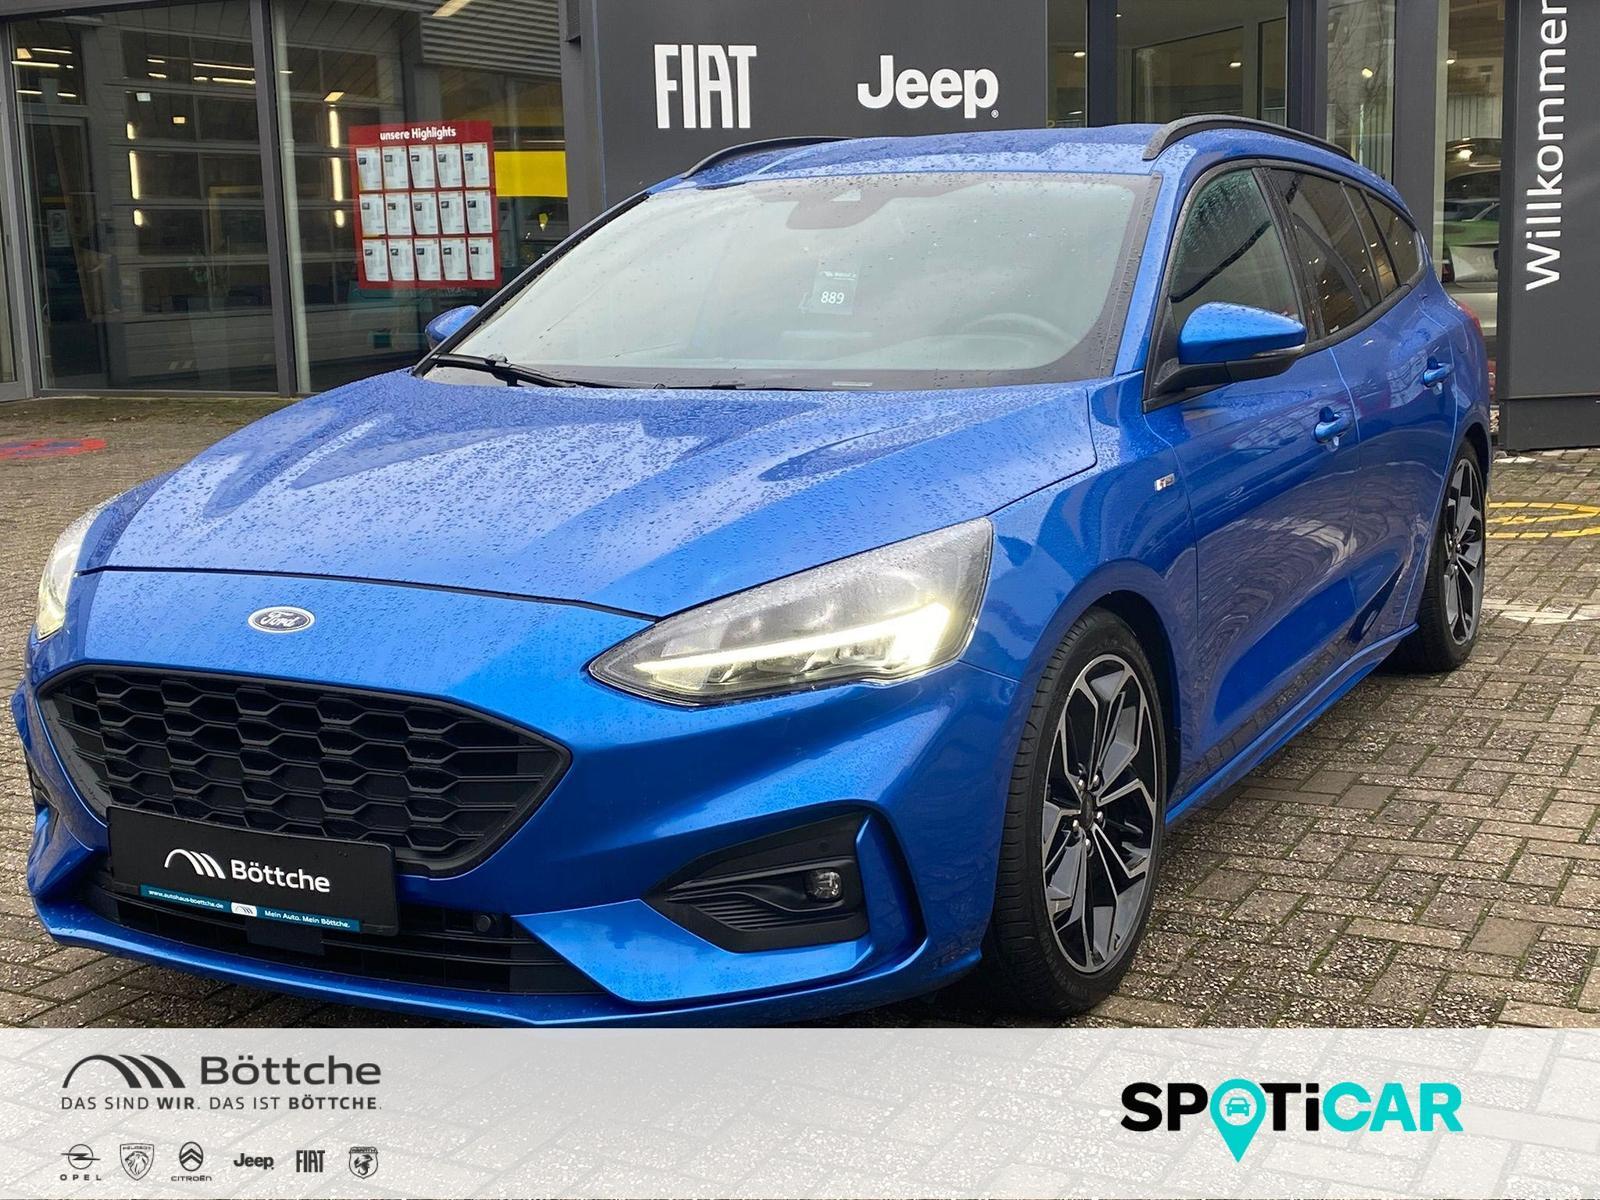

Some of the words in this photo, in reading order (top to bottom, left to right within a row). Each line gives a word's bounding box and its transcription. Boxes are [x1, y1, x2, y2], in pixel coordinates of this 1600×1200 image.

[654, 44, 757, 128] FIAT
[857, 55, 999, 119] Jeep
[380, 131, 410, 141] unsere
[411, 126, 457, 141] Highlights
[821, 291, 845, 304] 889
[261, 611, 300, 627] Ford
[230, 859, 331, 893] Böttche
[264, 910, 282, 918] Mein
[282, 913, 301, 921] Auto.
[302, 915, 320, 924] Mein
[320, 918, 351, 928] Böttche.
